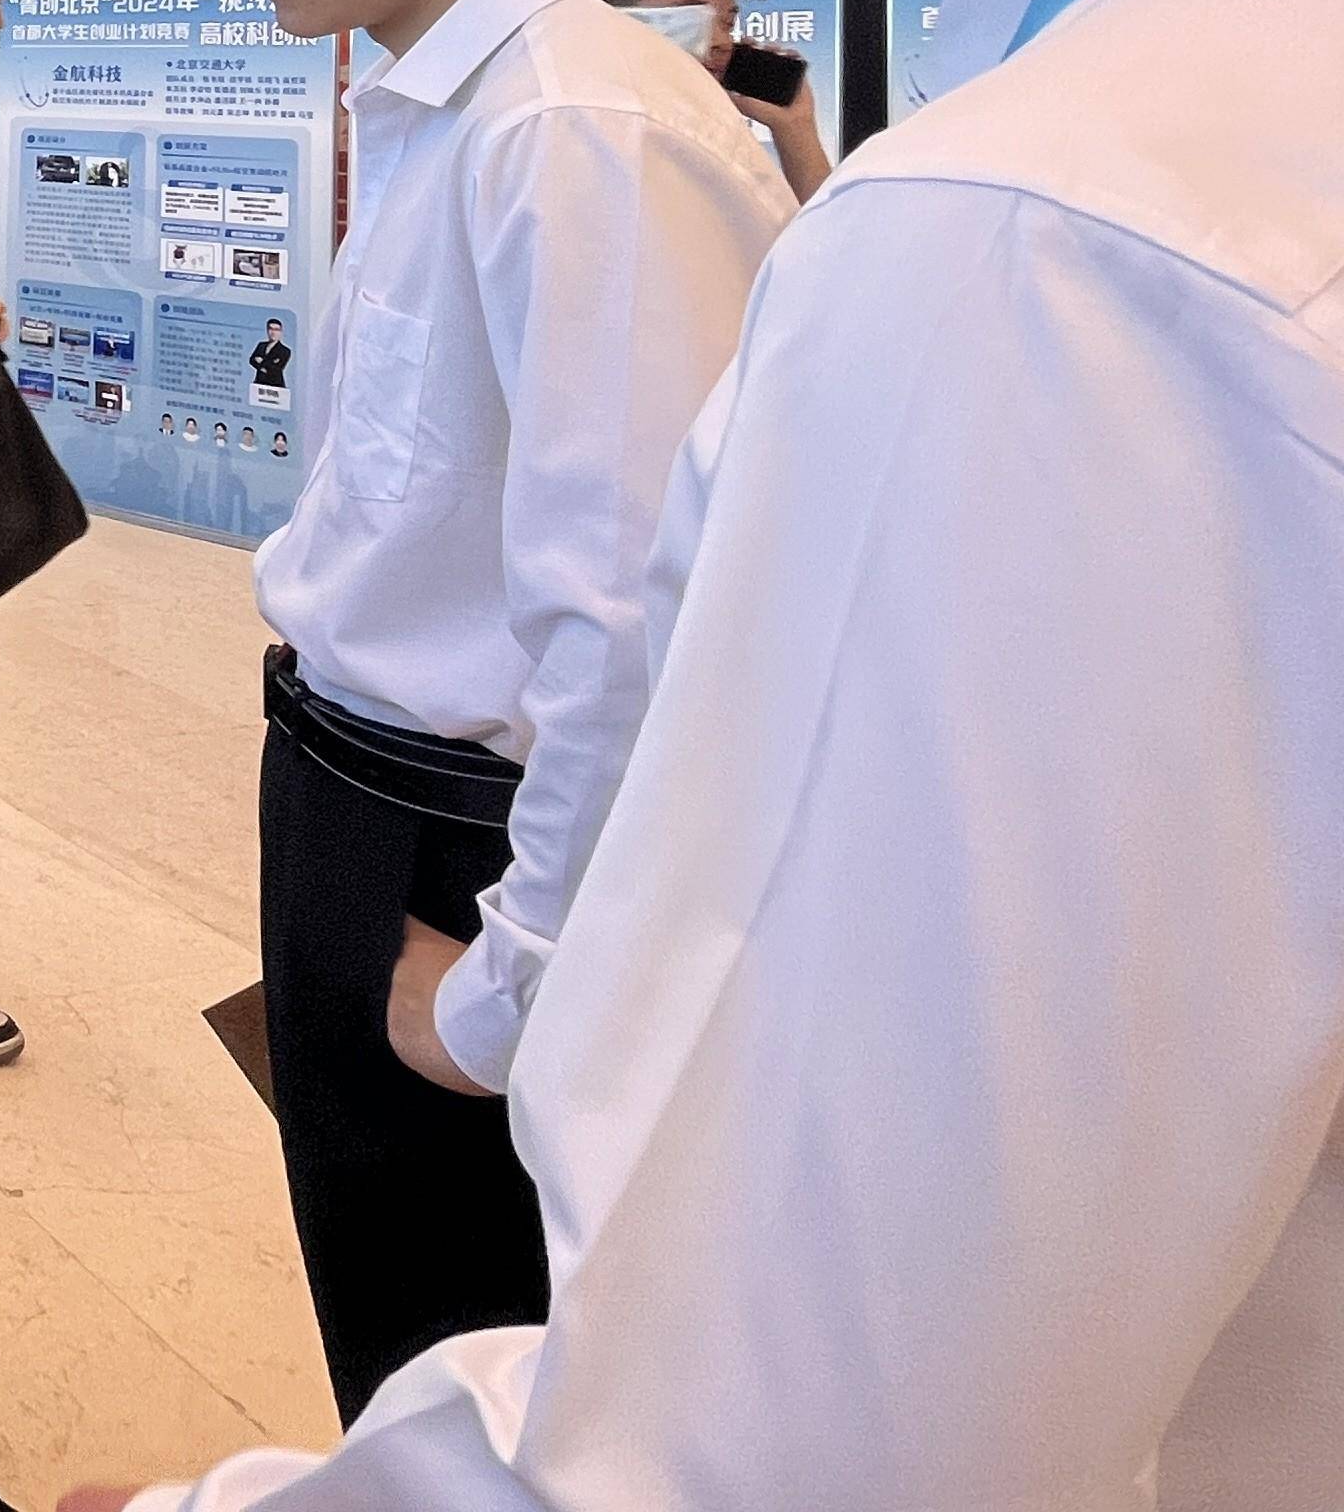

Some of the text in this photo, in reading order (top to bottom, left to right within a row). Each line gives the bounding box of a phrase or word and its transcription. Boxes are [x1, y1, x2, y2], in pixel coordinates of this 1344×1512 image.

[11, 21, 191, 41] 首都大学生创业计划竞赛
[52, 63, 123, 84] 金航科技
[174, 58, 247, 72] 北京交通大学
